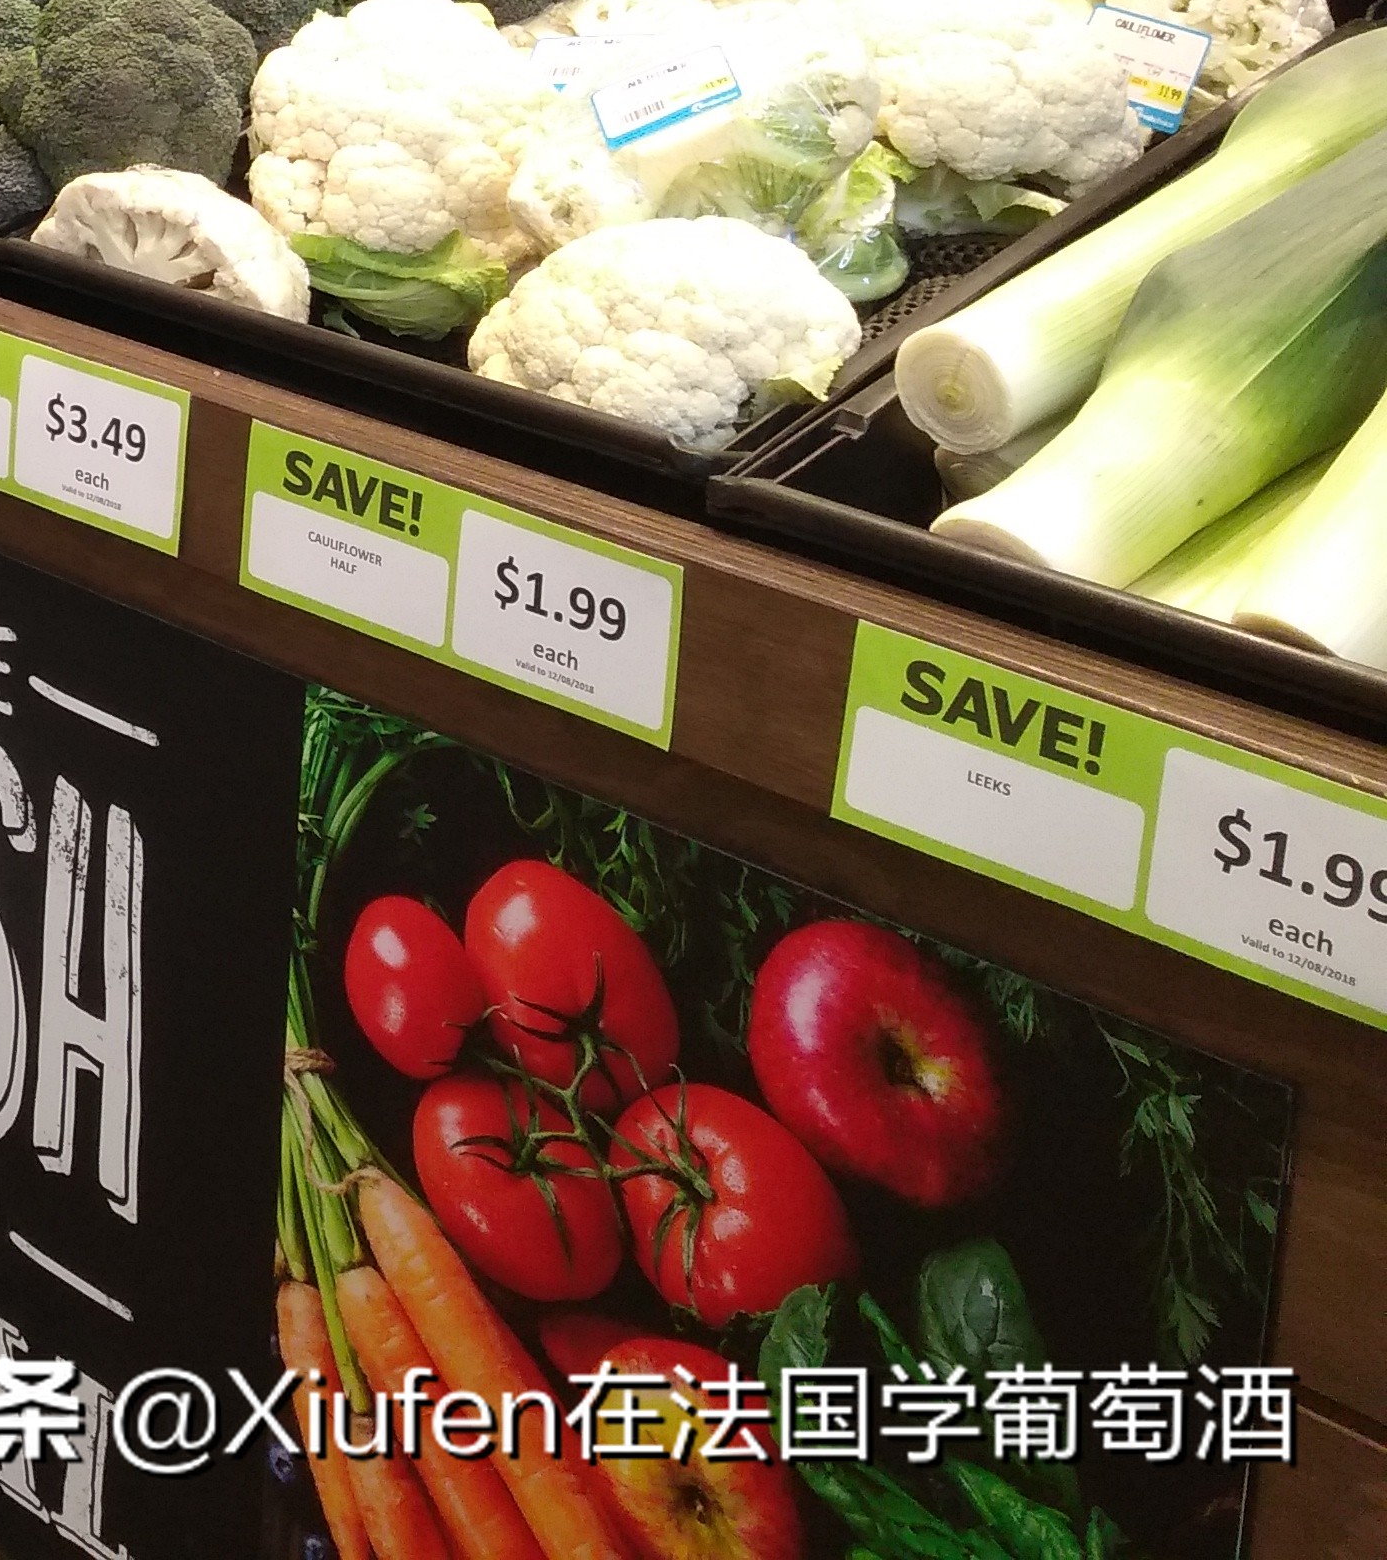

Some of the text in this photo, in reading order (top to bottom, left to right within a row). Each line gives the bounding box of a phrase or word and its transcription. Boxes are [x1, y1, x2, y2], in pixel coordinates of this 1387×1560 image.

[45, 392, 147, 464] $3.49
[75, 466, 110, 492] each
[282, 450, 424, 538] SAVE!
[307, 530, 383, 568] CAULIFLOWER
[329, 556, 358, 577] HALF
[494, 555, 628, 643] $1.99
[532, 640, 580, 672] each
[899, 659, 1106, 777] SAVE!
[967, 768, 1013, 798] LEEKS
[1267, 915, 1335, 958] each
[1240, 933, 1358, 988] Valid to 12/08/2018
